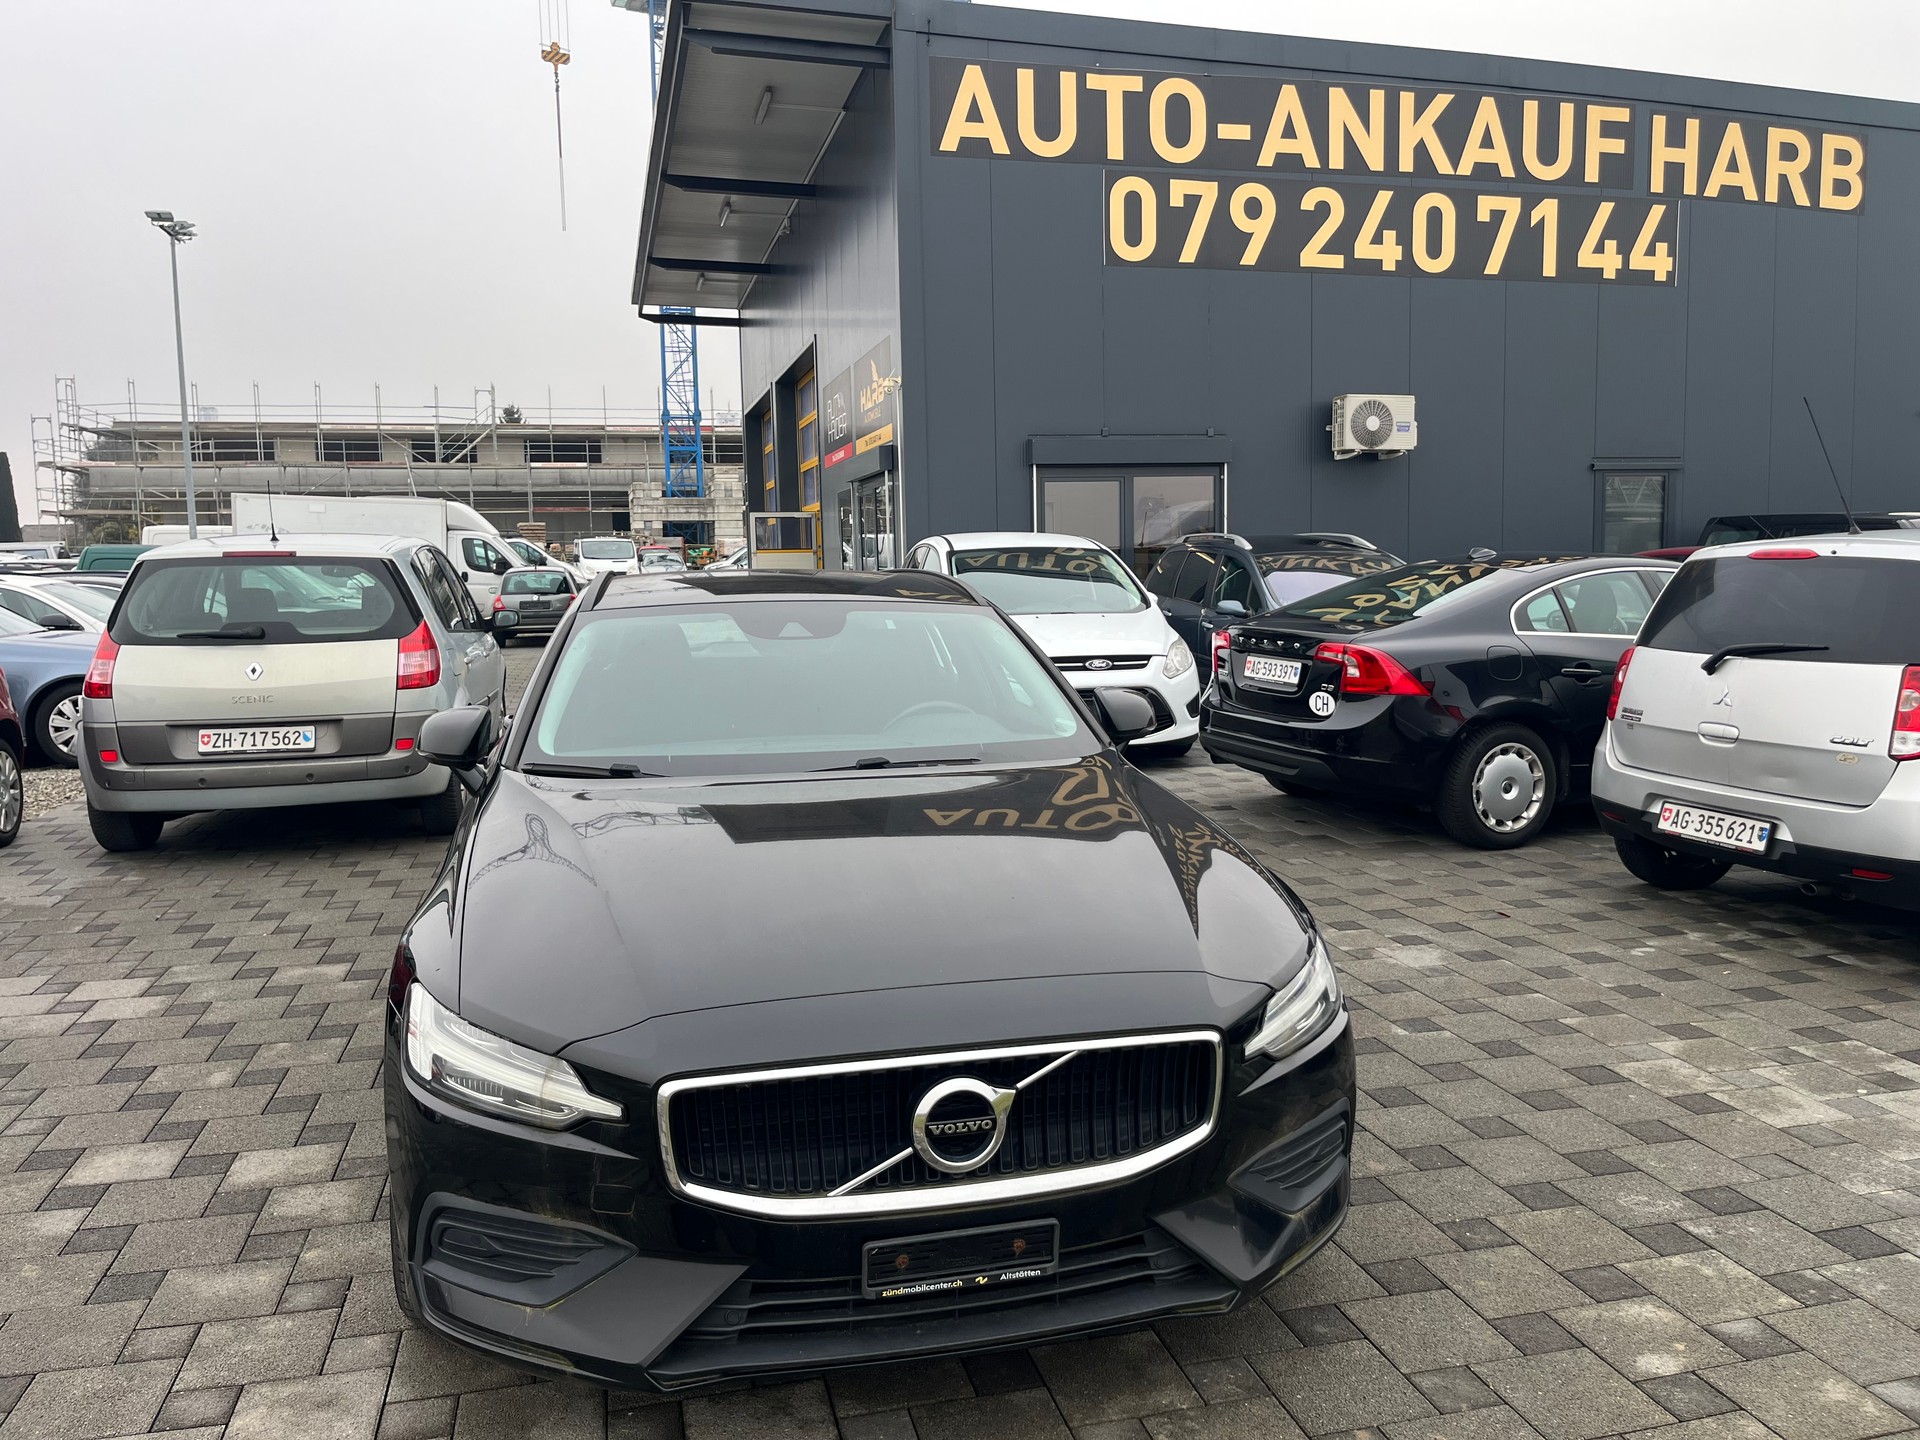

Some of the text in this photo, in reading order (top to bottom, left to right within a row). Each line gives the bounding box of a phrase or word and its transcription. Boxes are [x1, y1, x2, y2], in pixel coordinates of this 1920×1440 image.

[939, 64, 1864, 211] AUTO-ANKAUF HARB
[1109, 175, 1674, 283] 079 240 71 44
[231, 695, 274, 704] SCENIC
[1314, 695, 1329, 712] CH
[928, 1119, 993, 1135] VOLVO
[882, 1269, 1041, 1297] zündmobilcenter.ch Altstätten
